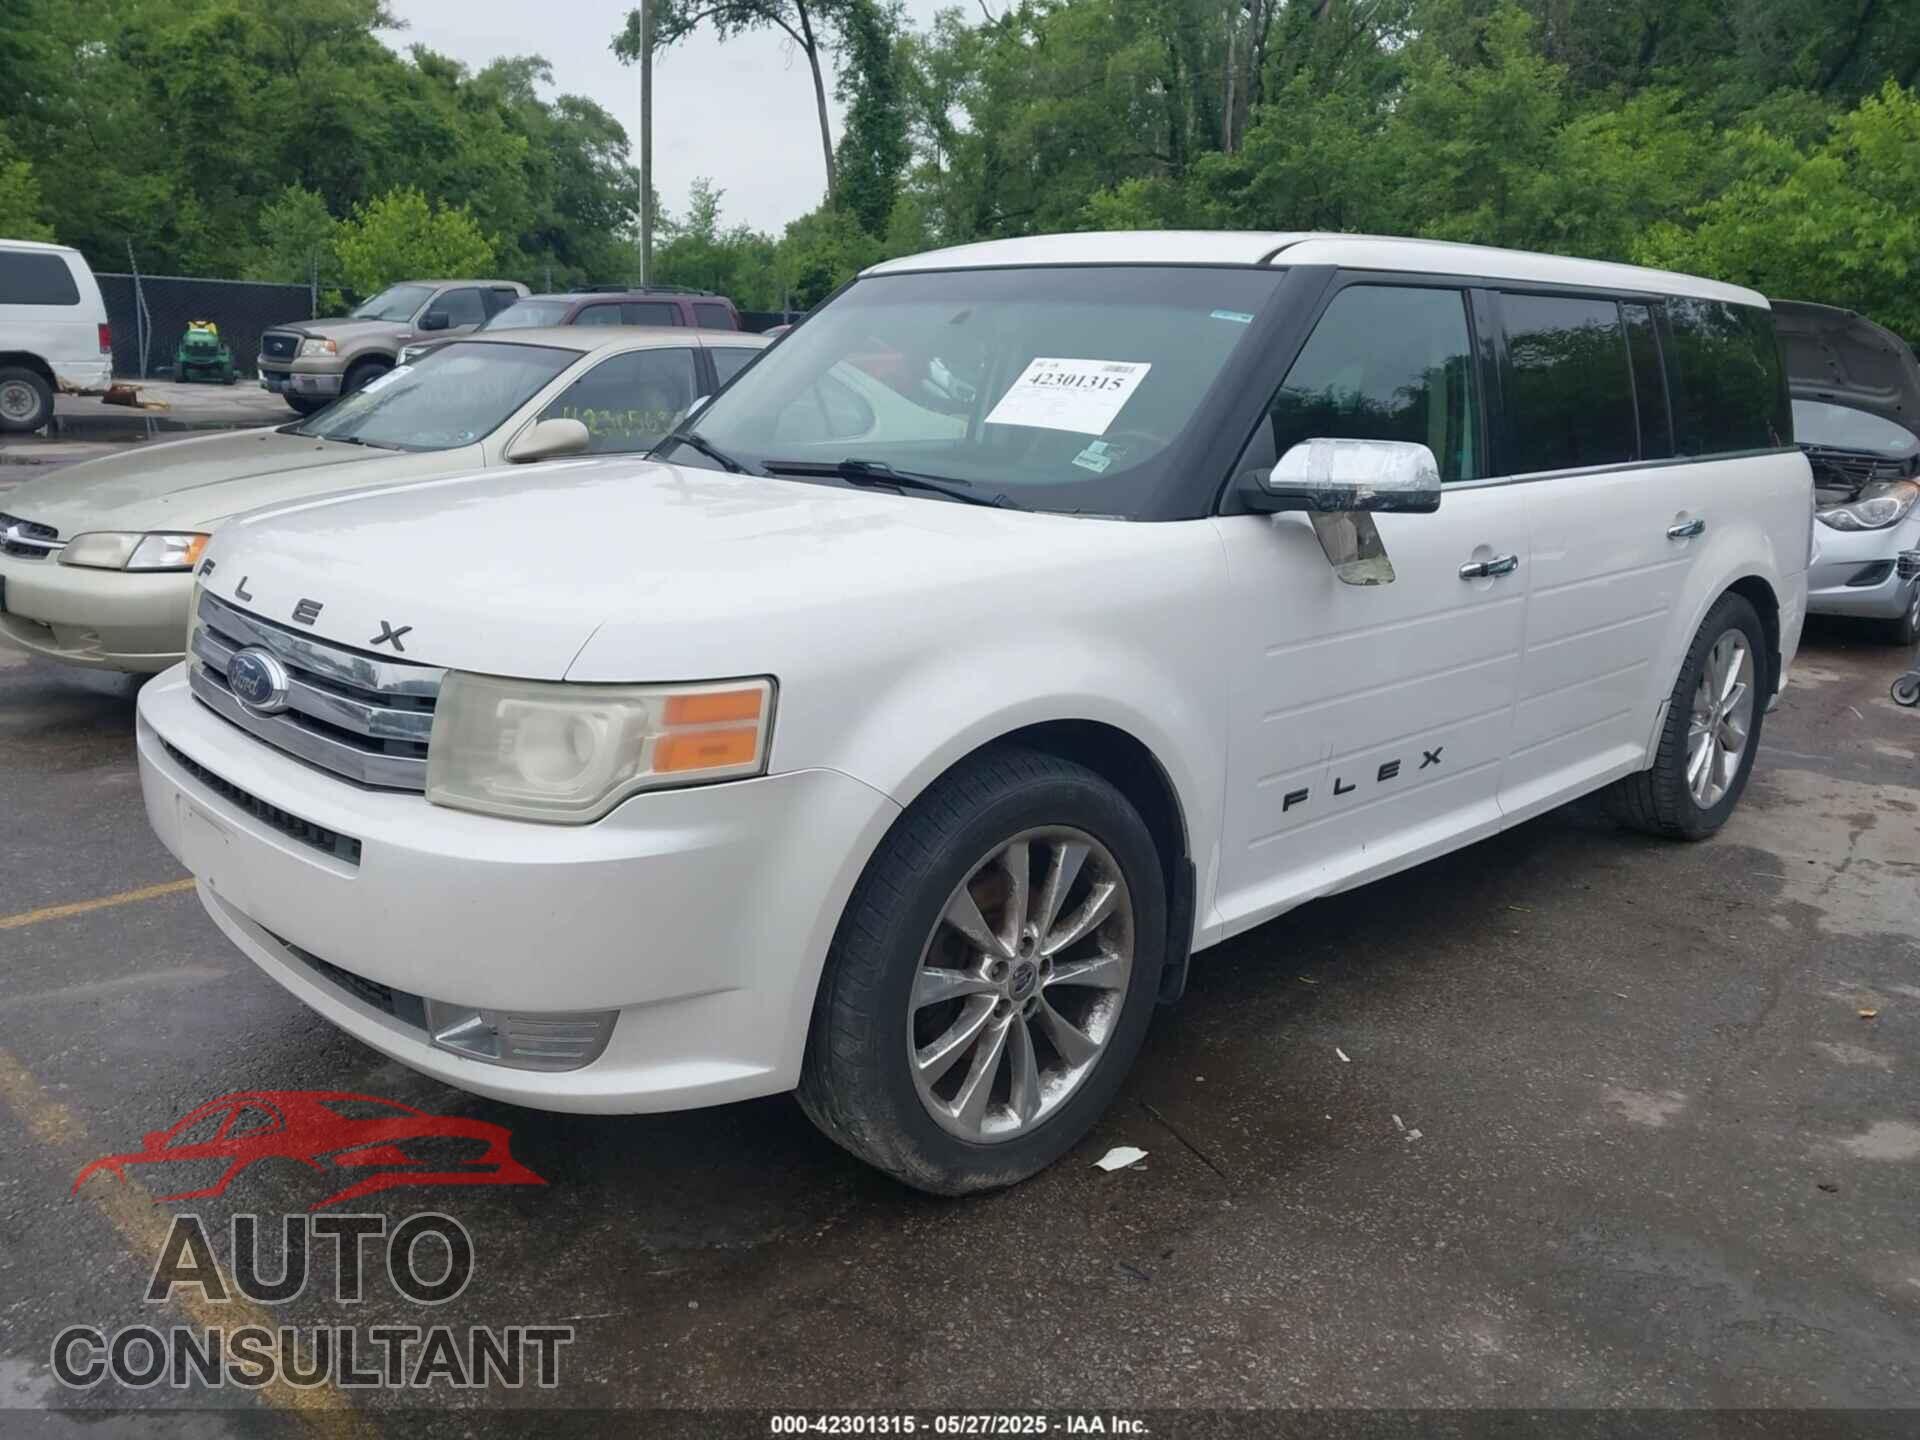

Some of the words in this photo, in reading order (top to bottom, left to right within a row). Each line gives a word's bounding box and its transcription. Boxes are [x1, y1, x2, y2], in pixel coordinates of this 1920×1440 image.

[1029, 372, 1126, 391] 42301315
[198, 558, 413, 652] FLEX
[1282, 746, 1444, 812] FLEX
